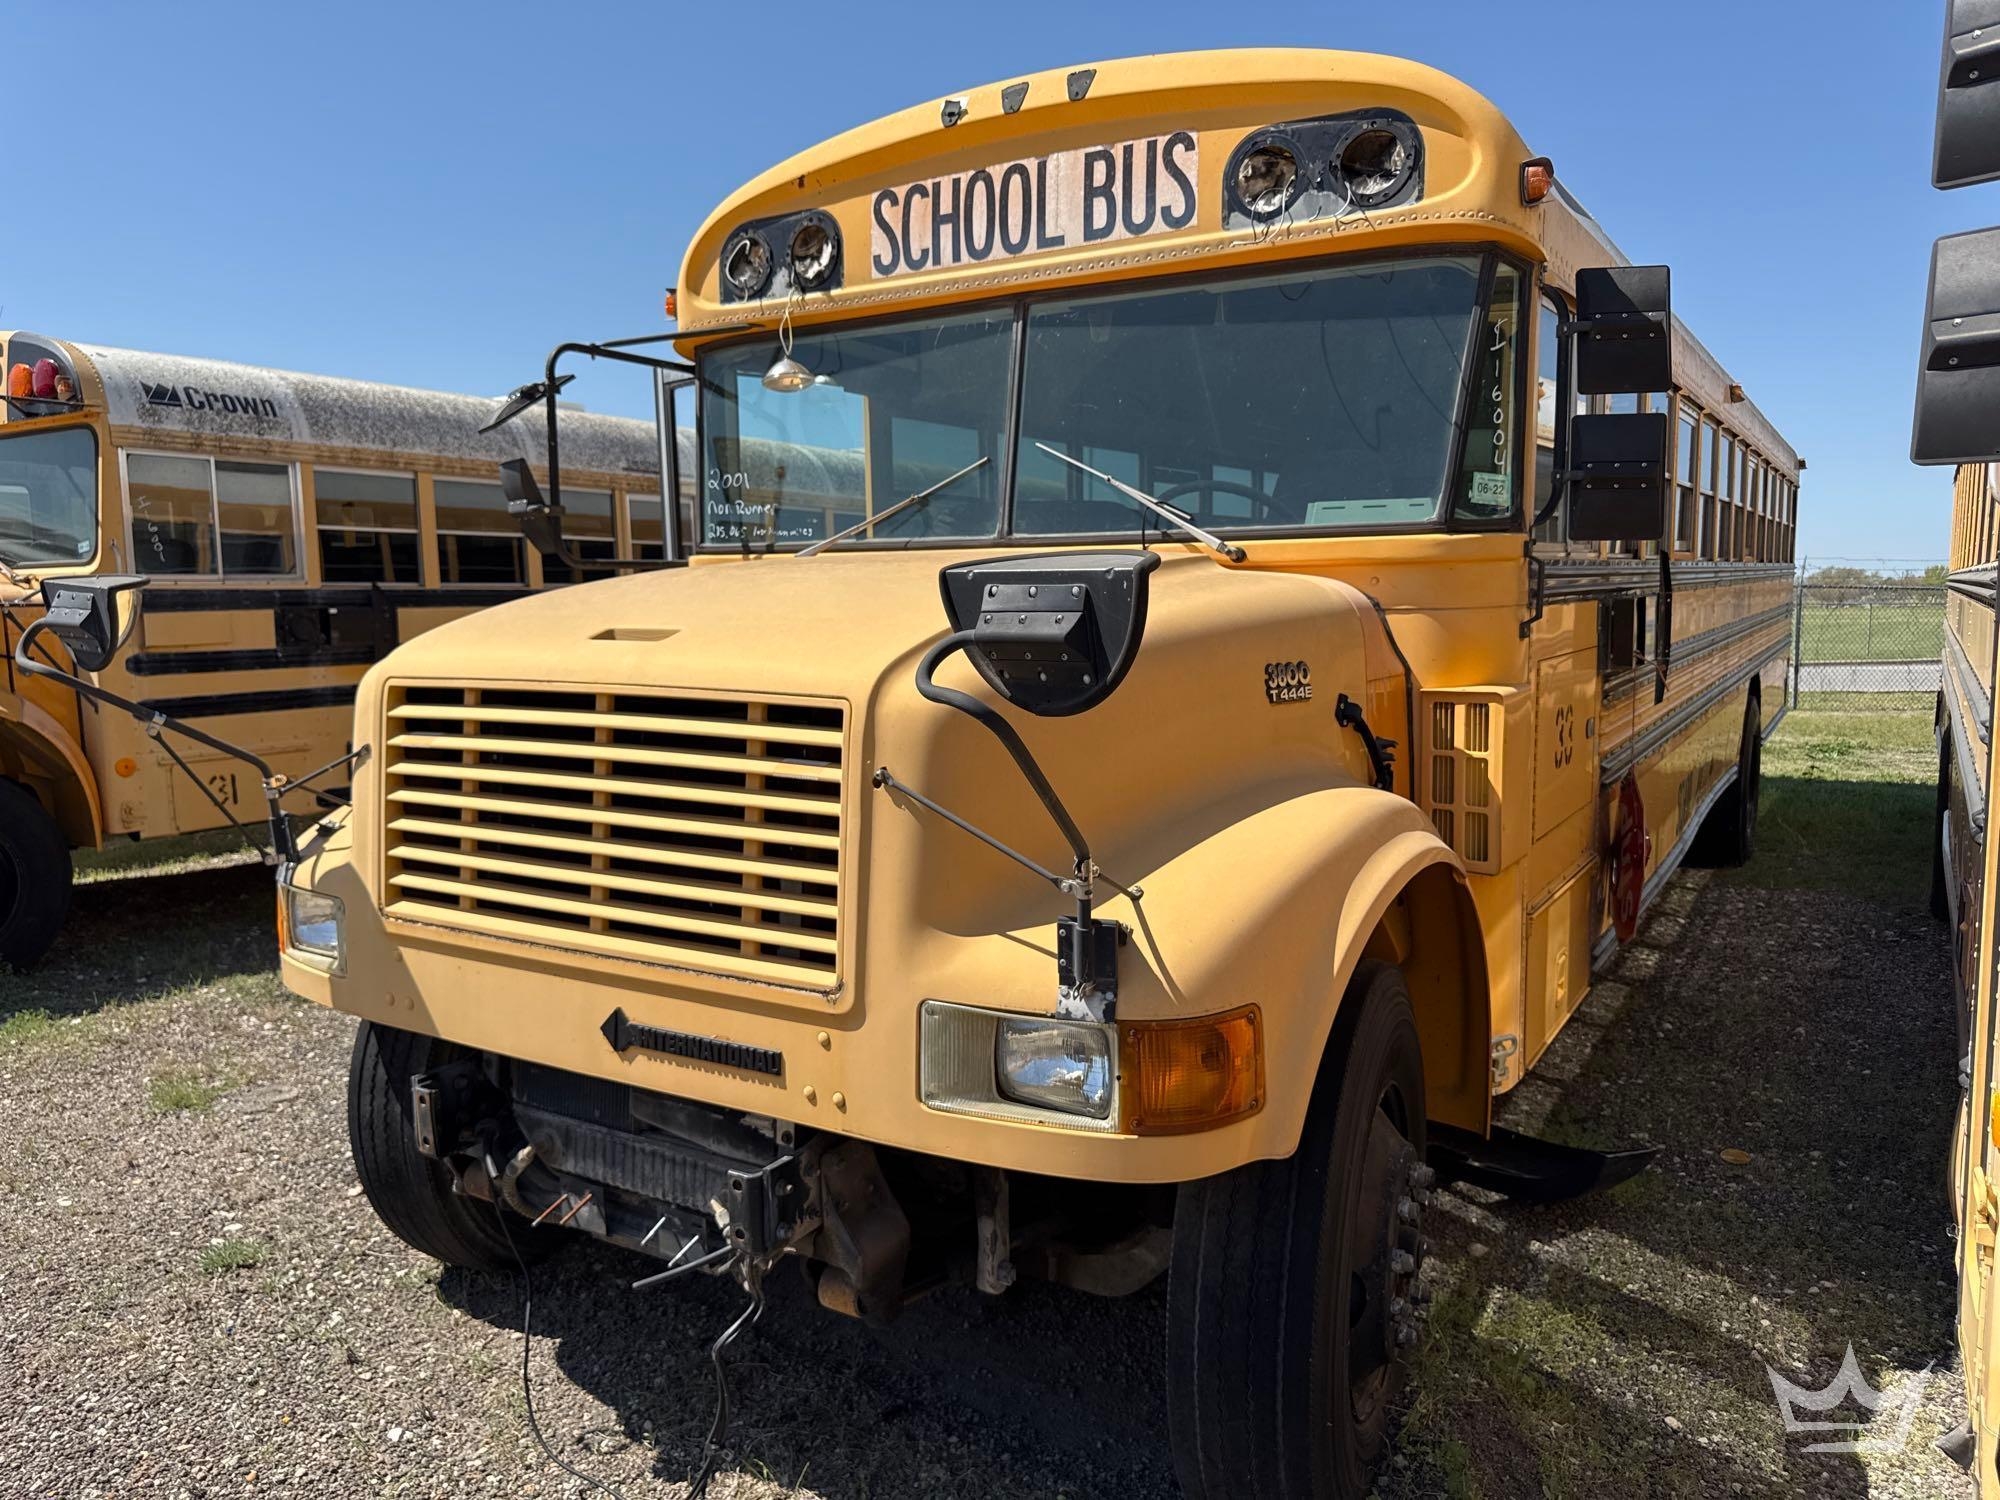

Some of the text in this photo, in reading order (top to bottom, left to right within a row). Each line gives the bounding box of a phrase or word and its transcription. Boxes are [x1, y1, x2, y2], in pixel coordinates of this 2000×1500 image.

[873, 131, 1197, 276] SCHOOL BUS
[183, 386, 277, 418] Crown
[708, 468, 750, 490] 2001
[1478, 482, 1505, 495] 06-22
[735, 499, 778, 516] Runner
[1266, 662, 1310, 688] 3800
[1280, 686, 1312, 701] 444E
[1554, 704, 1573, 769] 33
[209, 773, 238, 805] 31
[632, 1023, 783, 1076] INTERNATIONAL
